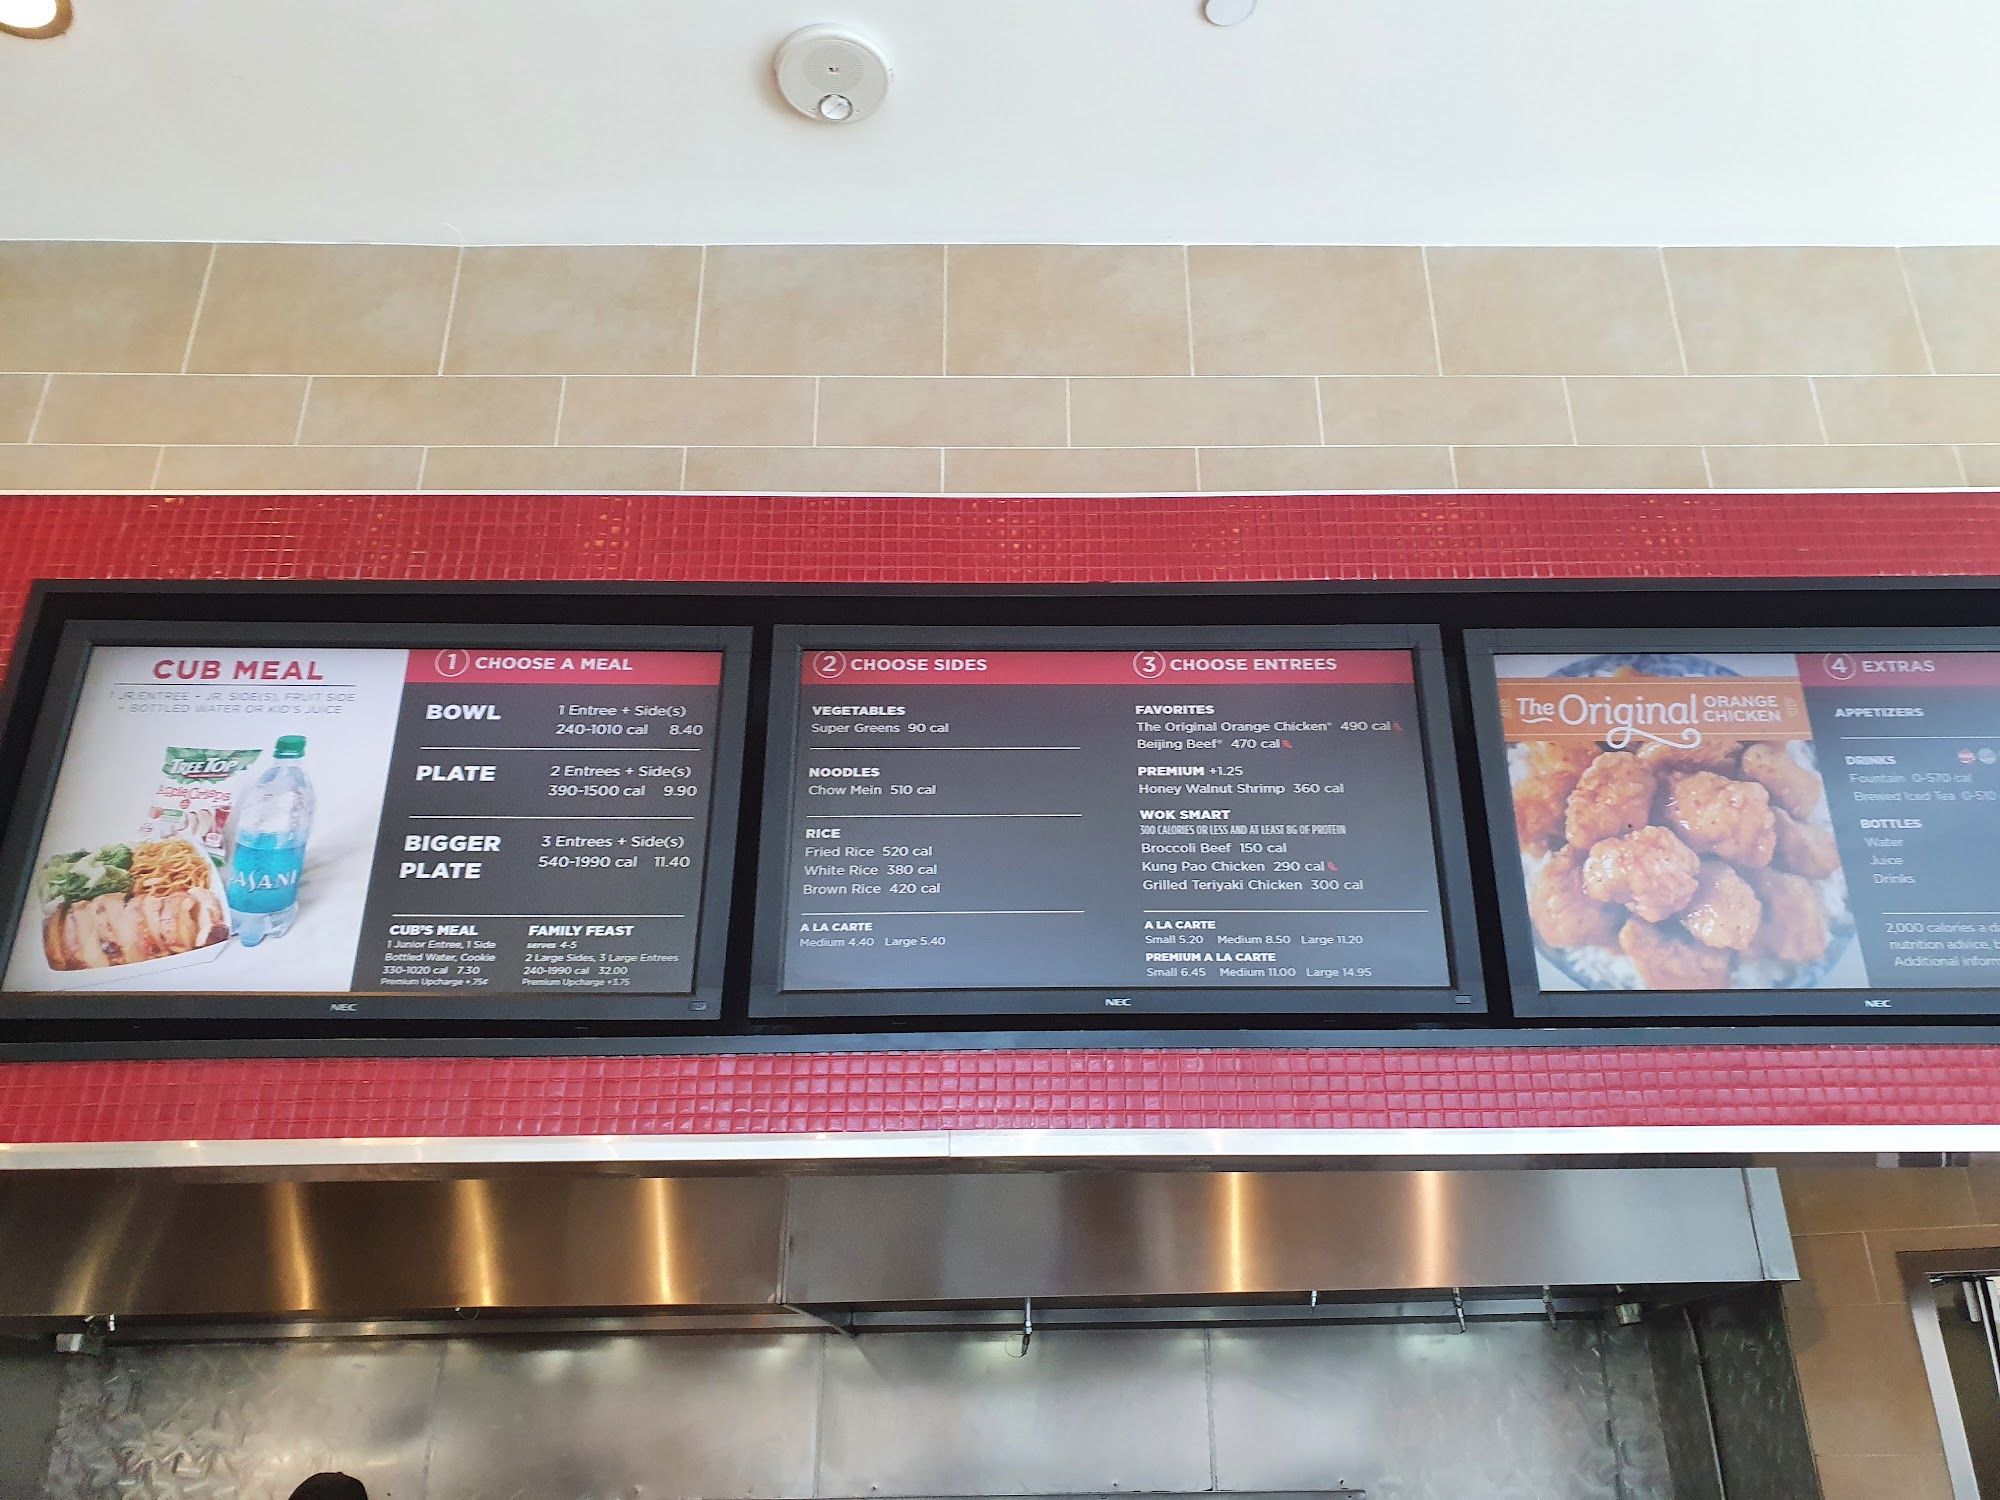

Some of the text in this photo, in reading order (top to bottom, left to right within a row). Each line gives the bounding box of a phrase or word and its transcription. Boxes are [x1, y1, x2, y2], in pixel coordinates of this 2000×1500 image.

[447, 654, 633, 671] 1 CHOOSE A MEAL
[822, 655, 988, 672] 2 CHOOSE SIDES
[1143, 657, 1337, 673] 3 CHOOSE ENTREES
[1831, 657, 1936, 673] 4 EXTRAS
[152, 660, 323, 680] CUB MEAL
[1703, 696, 1778, 707] ORANGE
[426, 705, 501, 720] BOWL
[558, 705, 687, 718] 1 Entree + Side(s)
[812, 706, 906, 716] VEGETABLES
[1135, 705, 1215, 715] FAVORITES
[1834, 708, 1925, 718] APPETIZERS
[1516, 697, 1555, 717] The
[1558, 693, 1701, 749] Original
[1703, 710, 1781, 722] CHICKEN
[555, 724, 704, 736] 240-1010 cal 8.40
[811, 722, 949, 734] Super Greens 90 cal
[1136, 722, 1162, 732] The
[1164, 722, 1217, 733] Original
[1220, 722, 1270, 733] Orange
[1340, 721, 1368, 731] 490
[1371, 721, 1391, 731] cal
[1137, 739, 1183, 751] Beijing
[1230, 739, 1257, 749] 470
[1260, 739, 1281, 749] cal
[416, 765, 496, 782] PLATE
[550, 766, 692, 778] 2 Entrees + Side(s)
[809, 768, 880, 777] NOODLES
[1137, 766, 1243, 776] PREMIUM +1.25
[548, 785, 698, 796] 390-1500 cal 9.90
[808, 784, 936, 795] Chow Mein 510 cal
[1139, 783, 1344, 795] Honey Walnut Shrimp 360 cal
[1139, 810, 1231, 820] WOK SMART
[1860, 819, 1922, 829] BOTTLES
[806, 829, 841, 839] RICE
[404, 835, 501, 852] BIGGER
[541, 836, 685, 849] 3 Entrees + Side(s)
[1141, 842, 1287, 853] Broccoli Beef 150 cal
[1864, 838, 1904, 847] Water
[805, 846, 933, 857] Fried Rice 520 cal
[538, 856, 691, 868] 540-1990 cal 11.40
[1870, 856, 1903, 865] Juice
[399, 862, 482, 879] PLATE
[804, 864, 937, 876] White Rice 380 cal
[1142, 861, 1325, 873] Kung Pao Chicken 290 cal
[1873, 874, 1916, 884] Drinks
[803, 883, 941, 895] Brown Rice 420 cal
[1142, 879, 1364, 892] Grilled Teriyaki Chicken 300 cal
[389, 925, 479, 936] CUB'S MEAL
[528, 925, 634, 936] FAMILY FEAST
[800, 922, 873, 932] A LA CARTE
[1144, 920, 1216, 930] A LA CARTE
[800, 936, 946, 948] Medium 4.40 Large 5.40
[1144, 935, 1364, 946] Small 5.20 Medium 8.50 Large 11.20
[525, 953, 679, 964] 2 Large Sides, 3 Large Entrees
[1145, 952, 1277, 962] PREMIUM A LA CARTE
[523, 966, 628, 975] 240-1990 cal 32.00
[1146, 967, 1373, 979] Small 6.45 Medium 11.00 Large 14.95
[329, 1003, 357, 1012] NEC
[1105, 998, 1132, 1007] NEC
[1865, 1000, 1892, 1008] NEC
